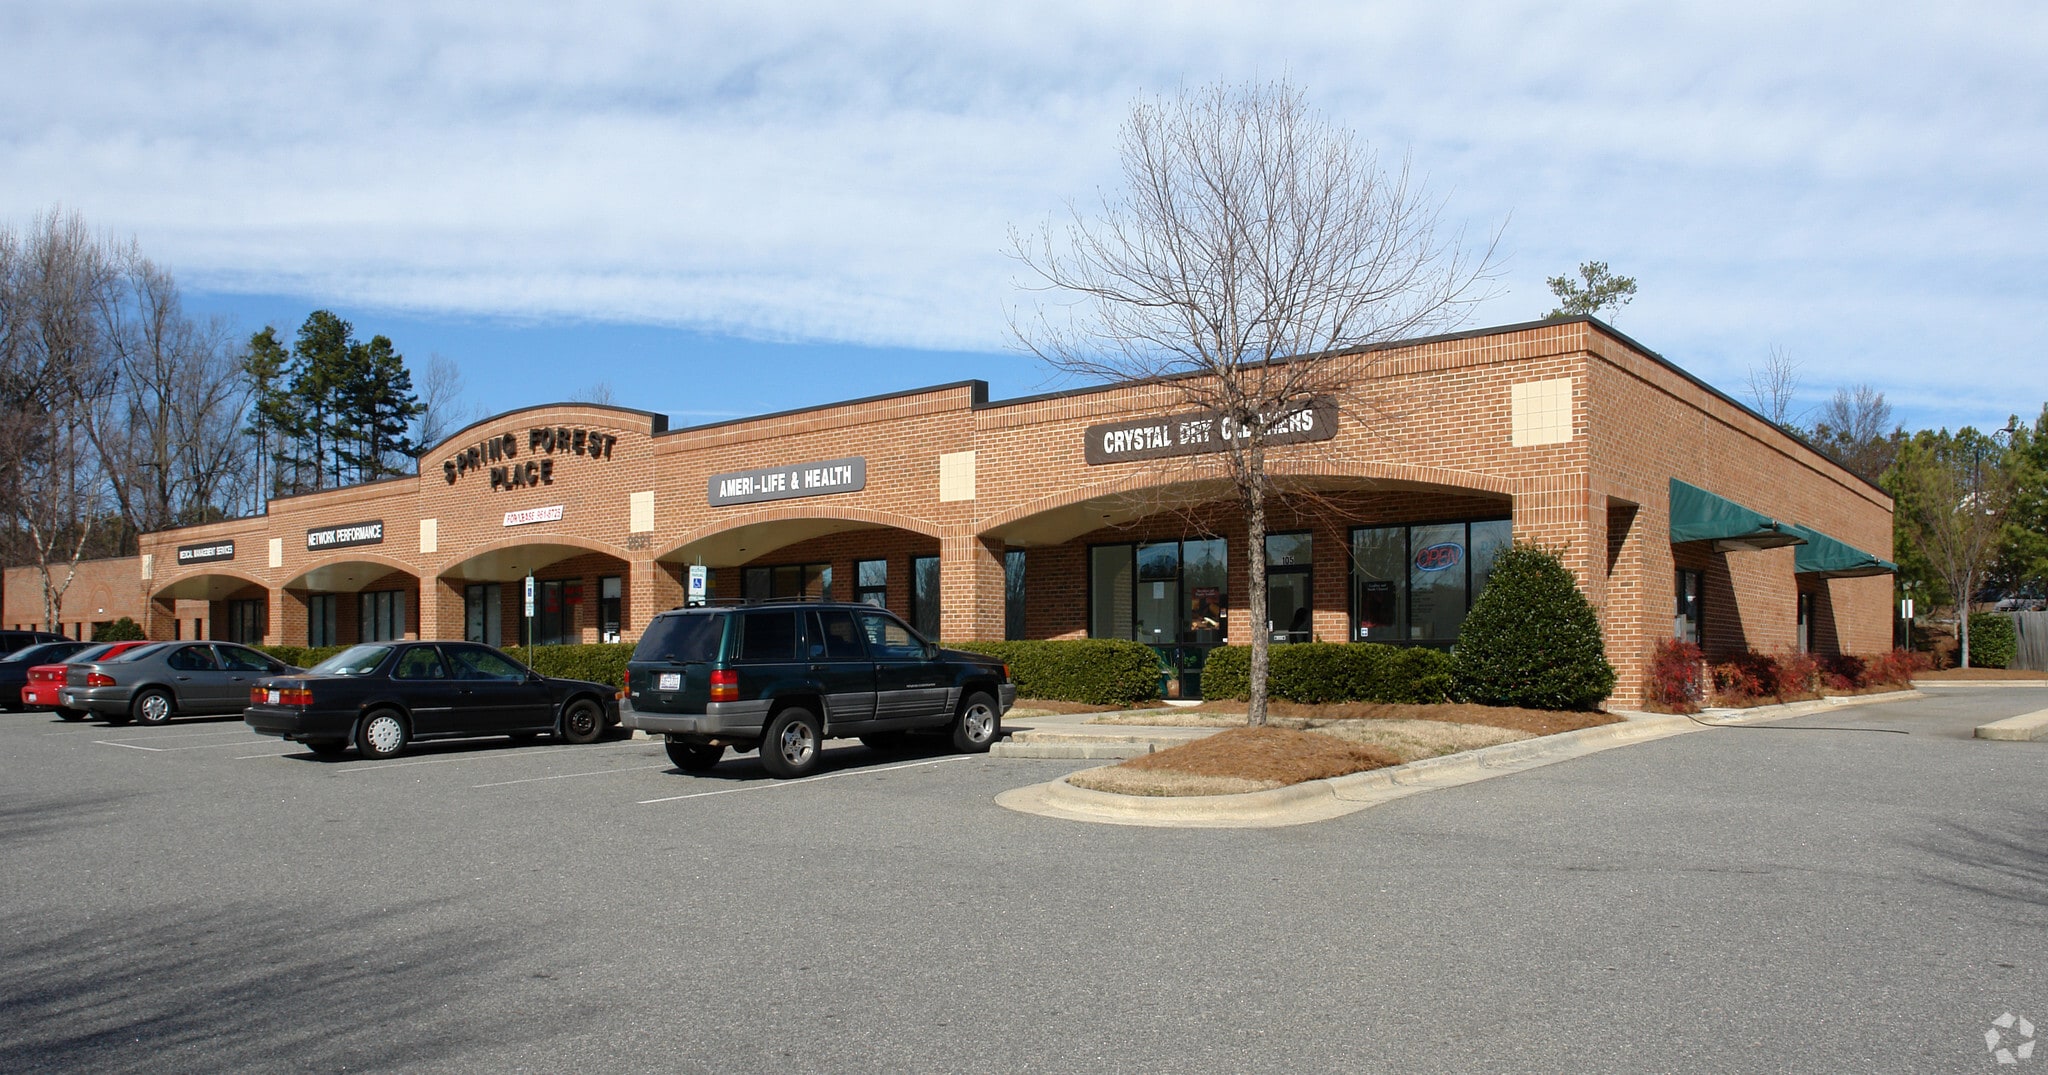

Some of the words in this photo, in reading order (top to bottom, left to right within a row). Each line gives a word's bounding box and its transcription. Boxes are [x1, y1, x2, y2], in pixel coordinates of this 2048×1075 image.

[1103, 425, 1172, 454] CRYSTAL
[1179, 419, 1213, 445] DRY
[443, 432, 518, 486] SPRING
[529, 427, 617, 461] FOREST
[490, 458, 554, 492] PLACE
[719, 473, 786, 498] AMERI-LIFE
[790, 471, 800, 490] &
[804, 465, 852, 489] HEALTH
[308, 530, 336, 546] NETWORK
[336, 524, 382, 542] PERFORMANCE
[1282, 555, 1294, 566] 105
[1417, 547, 1460, 567] OPEN
